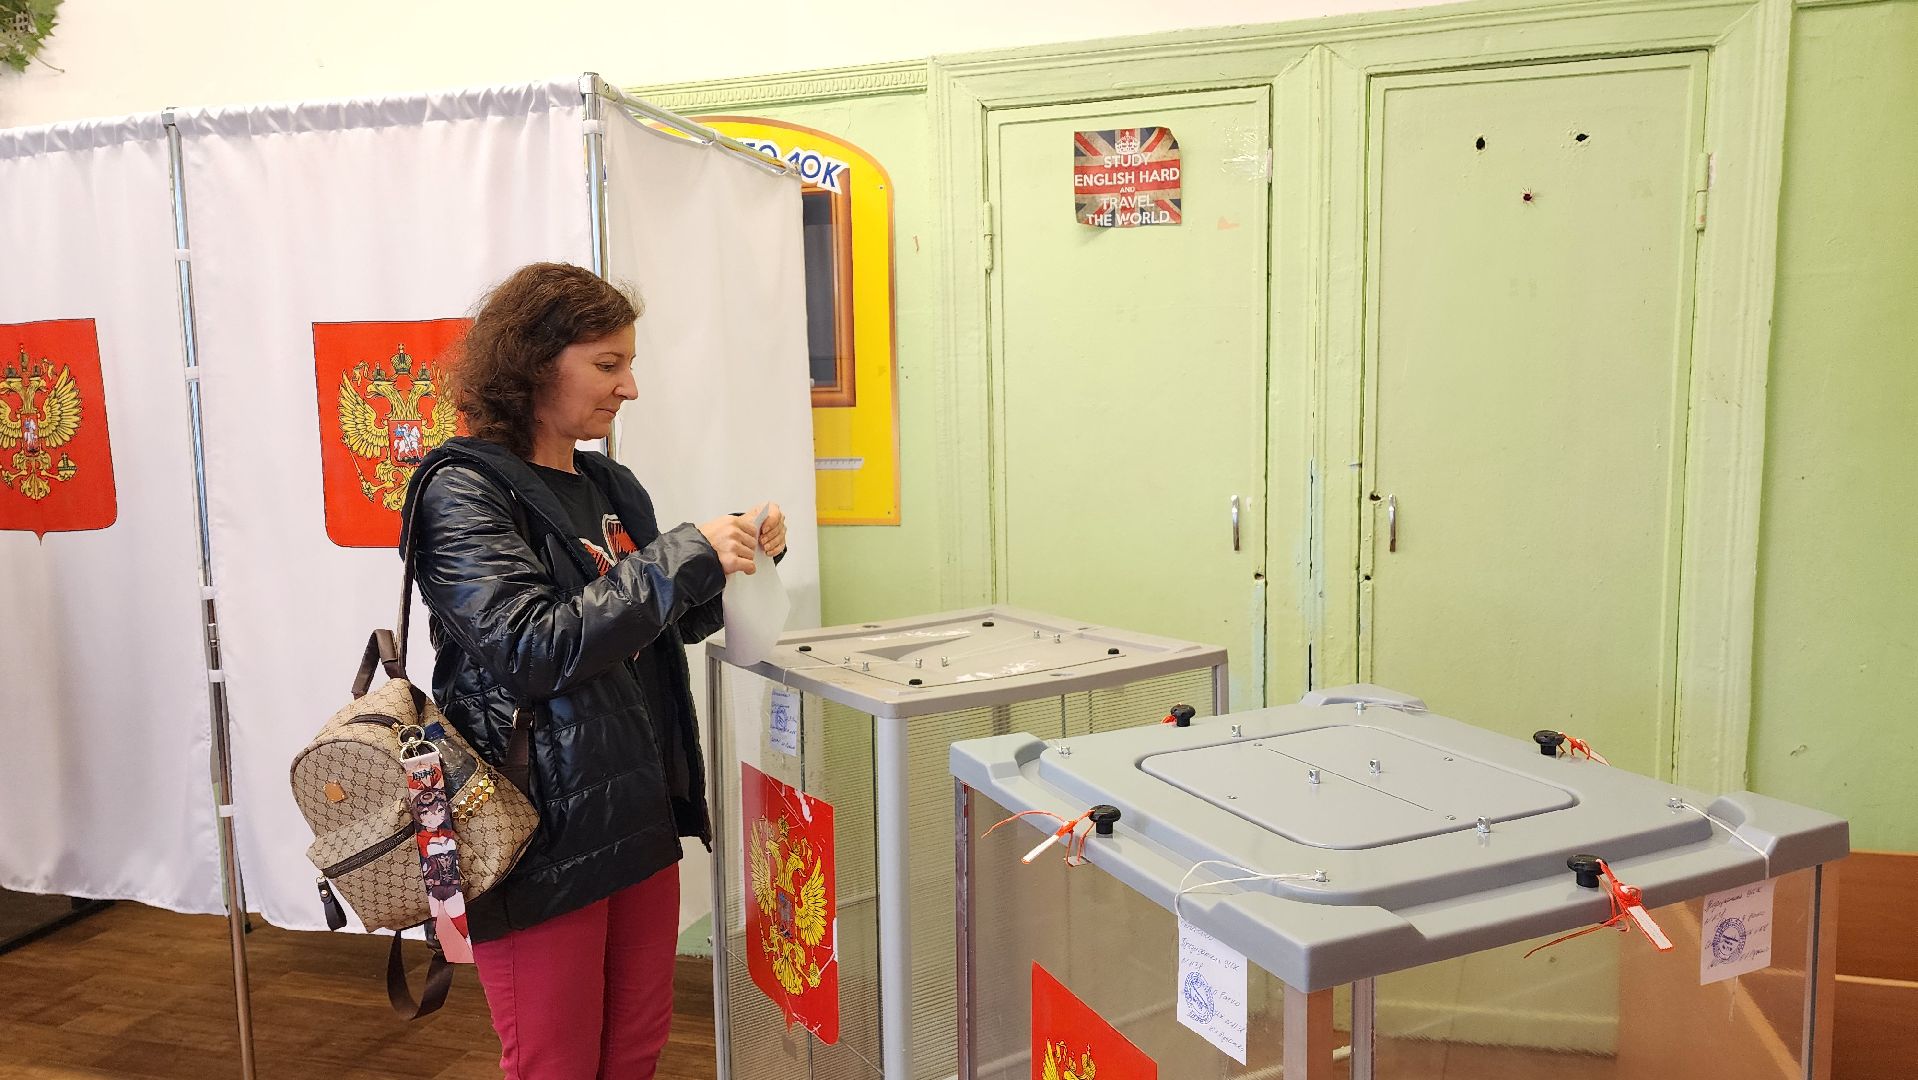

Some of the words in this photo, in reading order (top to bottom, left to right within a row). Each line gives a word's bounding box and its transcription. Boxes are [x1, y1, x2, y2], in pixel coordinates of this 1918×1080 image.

[1103, 153, 1151, 168] STUDY
[1075, 171, 1135, 186] ENGLISH
[1140, 168, 1180, 183] HARD
[1100, 195, 1154, 210] TRAVEL
[1086, 213, 1112, 226] THE
[1115, 210, 1170, 225] WORLD
